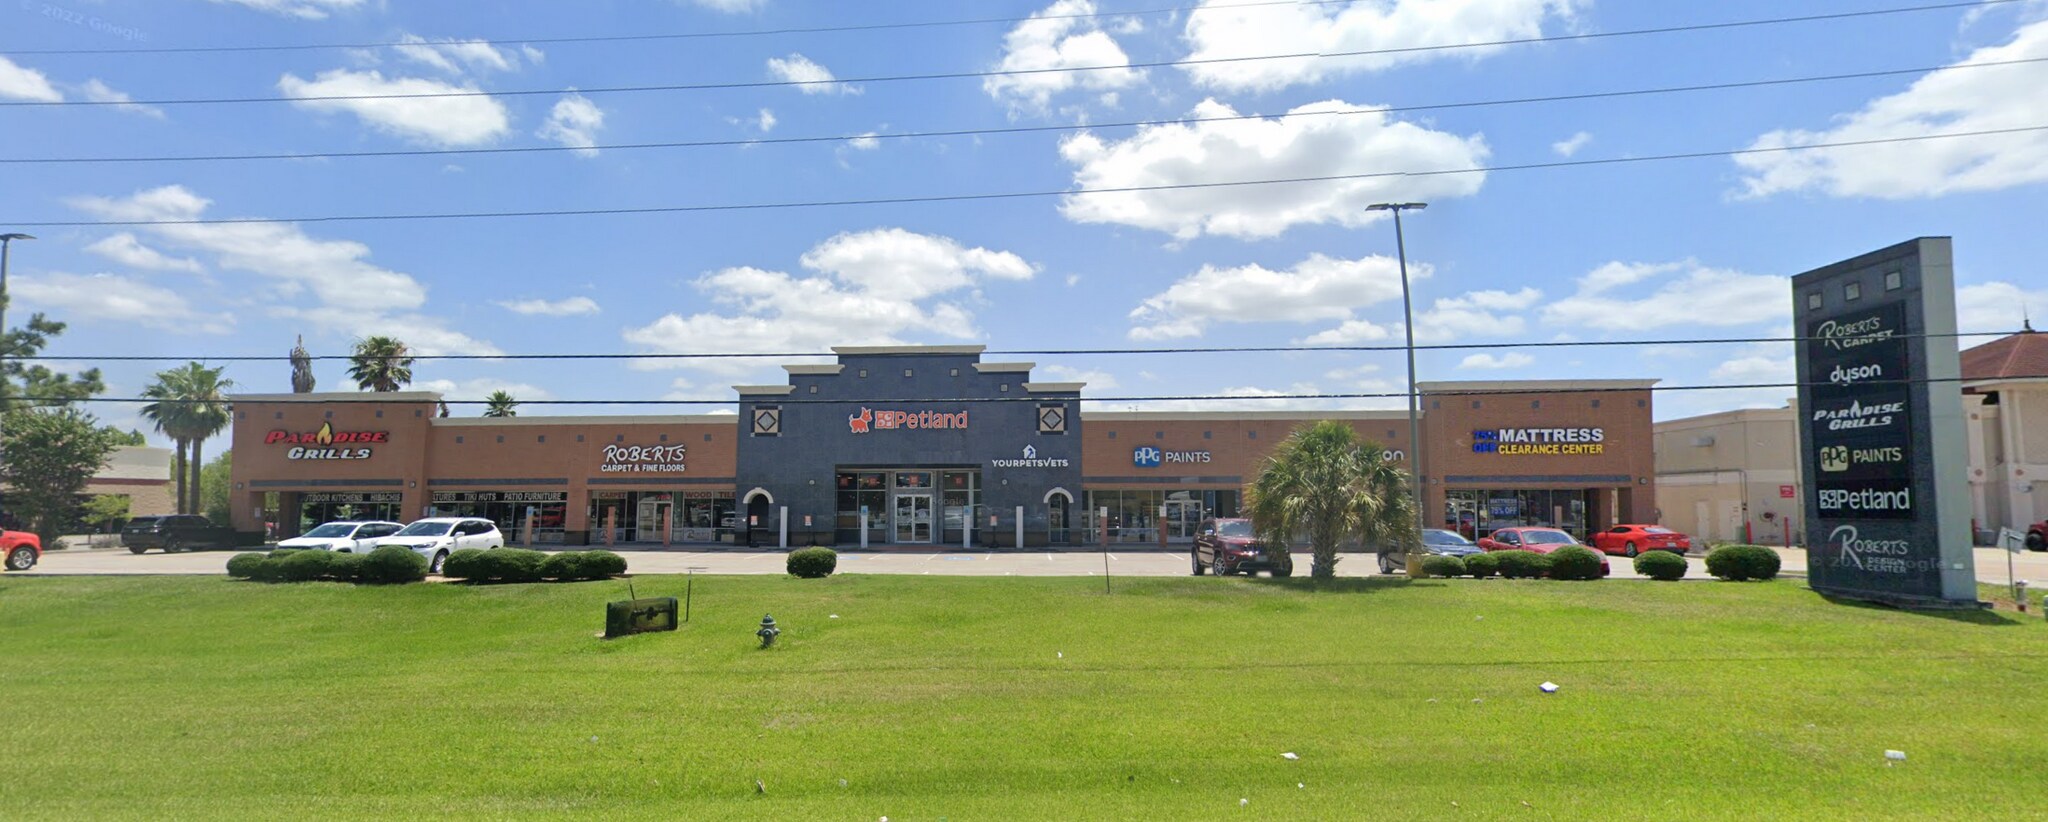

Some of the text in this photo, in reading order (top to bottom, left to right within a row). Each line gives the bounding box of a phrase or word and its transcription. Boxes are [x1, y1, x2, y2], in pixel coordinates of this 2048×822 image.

[1816, 316, 1880, 350] ROBERTS
[1830, 364, 1882, 386] dyson
[895, 410, 968, 429] Petland
[1813, 400, 1904, 421] PARADISE
[1829, 416, 1892, 430] GRILLS
[264, 423, 389, 445] PARADISE
[1499, 428, 1604, 442] MATTRESS
[287, 447, 371, 460] GRILLS
[602, 444, 686, 464] ROBERTS
[1134, 447, 1211, 464] PPG PAINTS
[1498, 443, 1604, 455] CLEARANCE CENTER
[1821, 446, 1902, 467] PPG PAINTS
[601, 464, 685, 472] CARPET & FINE FLOORS
[331, 493, 363, 501] KITCHENS
[478, 493, 496, 501] HUTS
[504, 493, 523, 501] PATIO
[524, 492, 561, 501] FURNITURE
[1837, 487, 1910, 509] Petland
[1829, 525, 1909, 570] ROBERTS
[1867, 564, 1907, 573] CENTER
